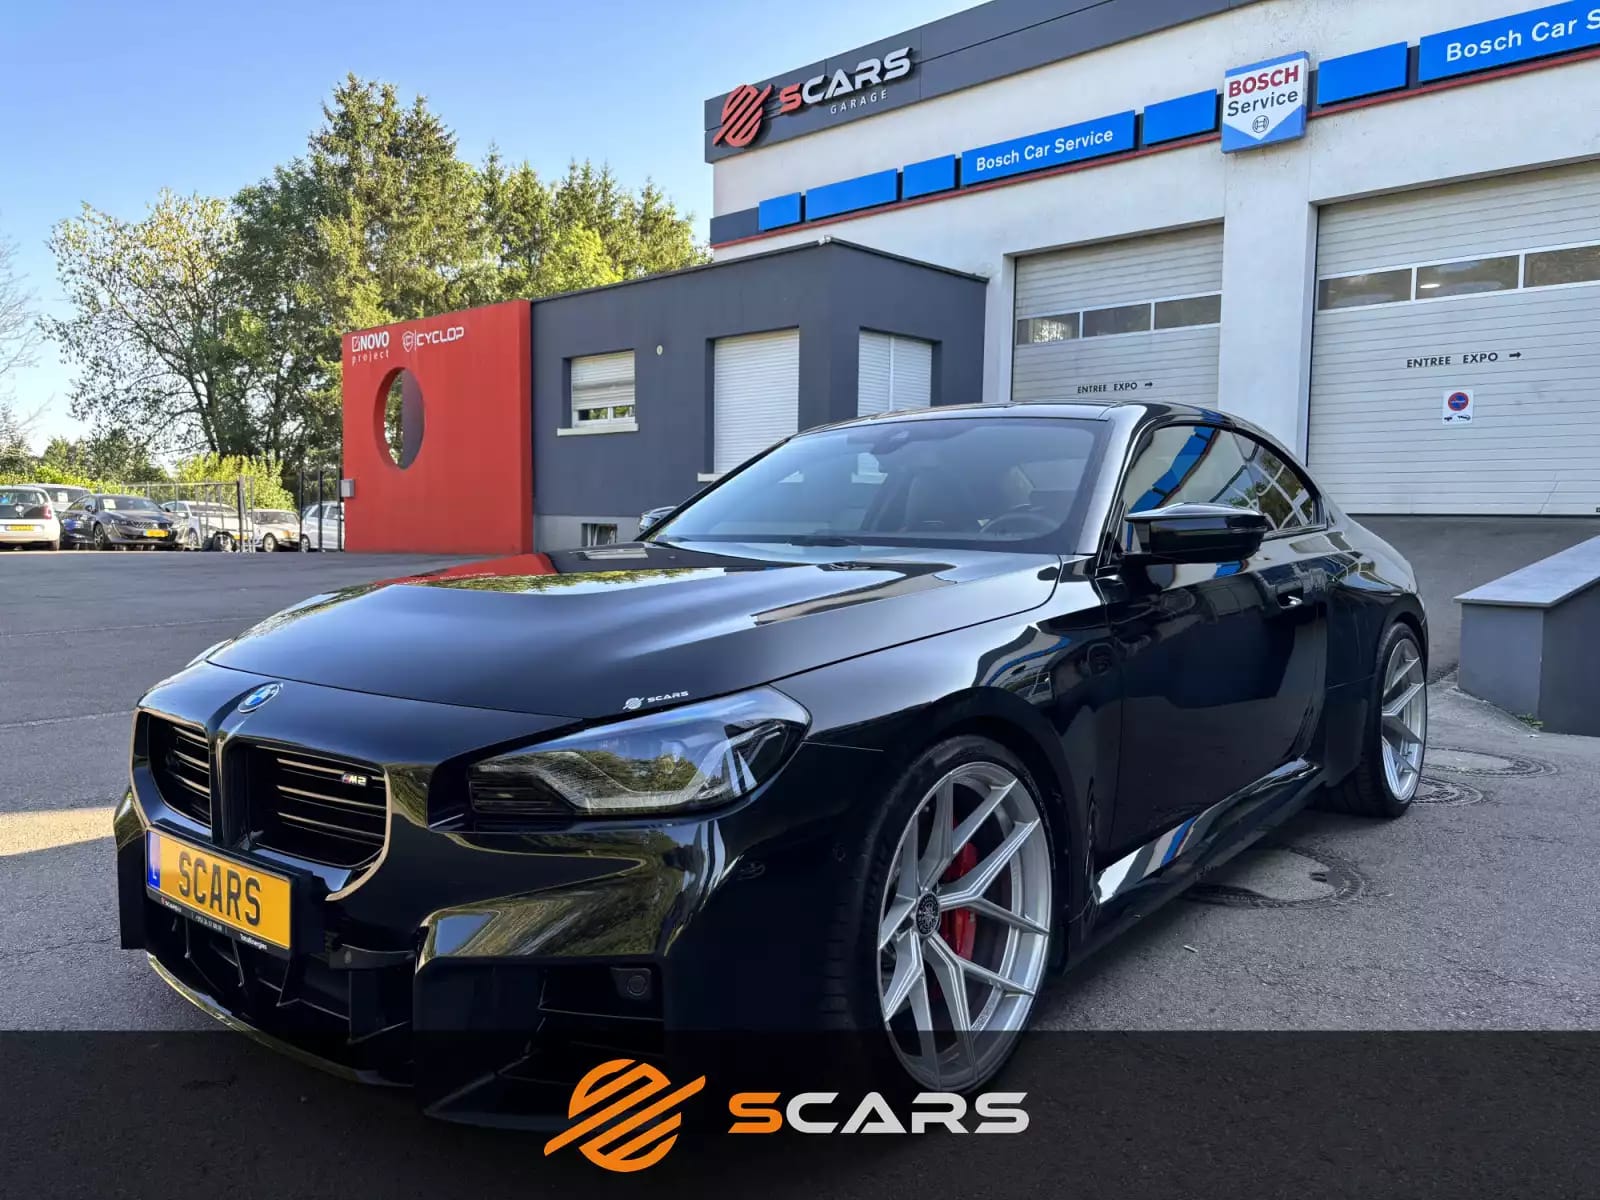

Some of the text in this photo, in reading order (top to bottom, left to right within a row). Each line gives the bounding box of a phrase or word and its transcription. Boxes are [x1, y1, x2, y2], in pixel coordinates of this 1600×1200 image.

[1446, 29, 1522, 62] Bosch
[1531, 18, 1578, 42] Car
[779, 46, 911, 113] SCARS
[1229, 65, 1299, 98] BOSCH
[830, 89, 888, 114] GARAGE
[1227, 90, 1298, 117] Service
[976, 130, 1114, 172] Bosch Car Service
[416, 327, 465, 347] CYCLOP
[351, 349, 389, 366] project
[1406, 352, 1499, 369] ENTREE EXPO
[1077, 382, 1138, 394] ENTREE EXPO
[647, 690, 689, 703] SCARS
[178, 851, 261, 927] SCARS
